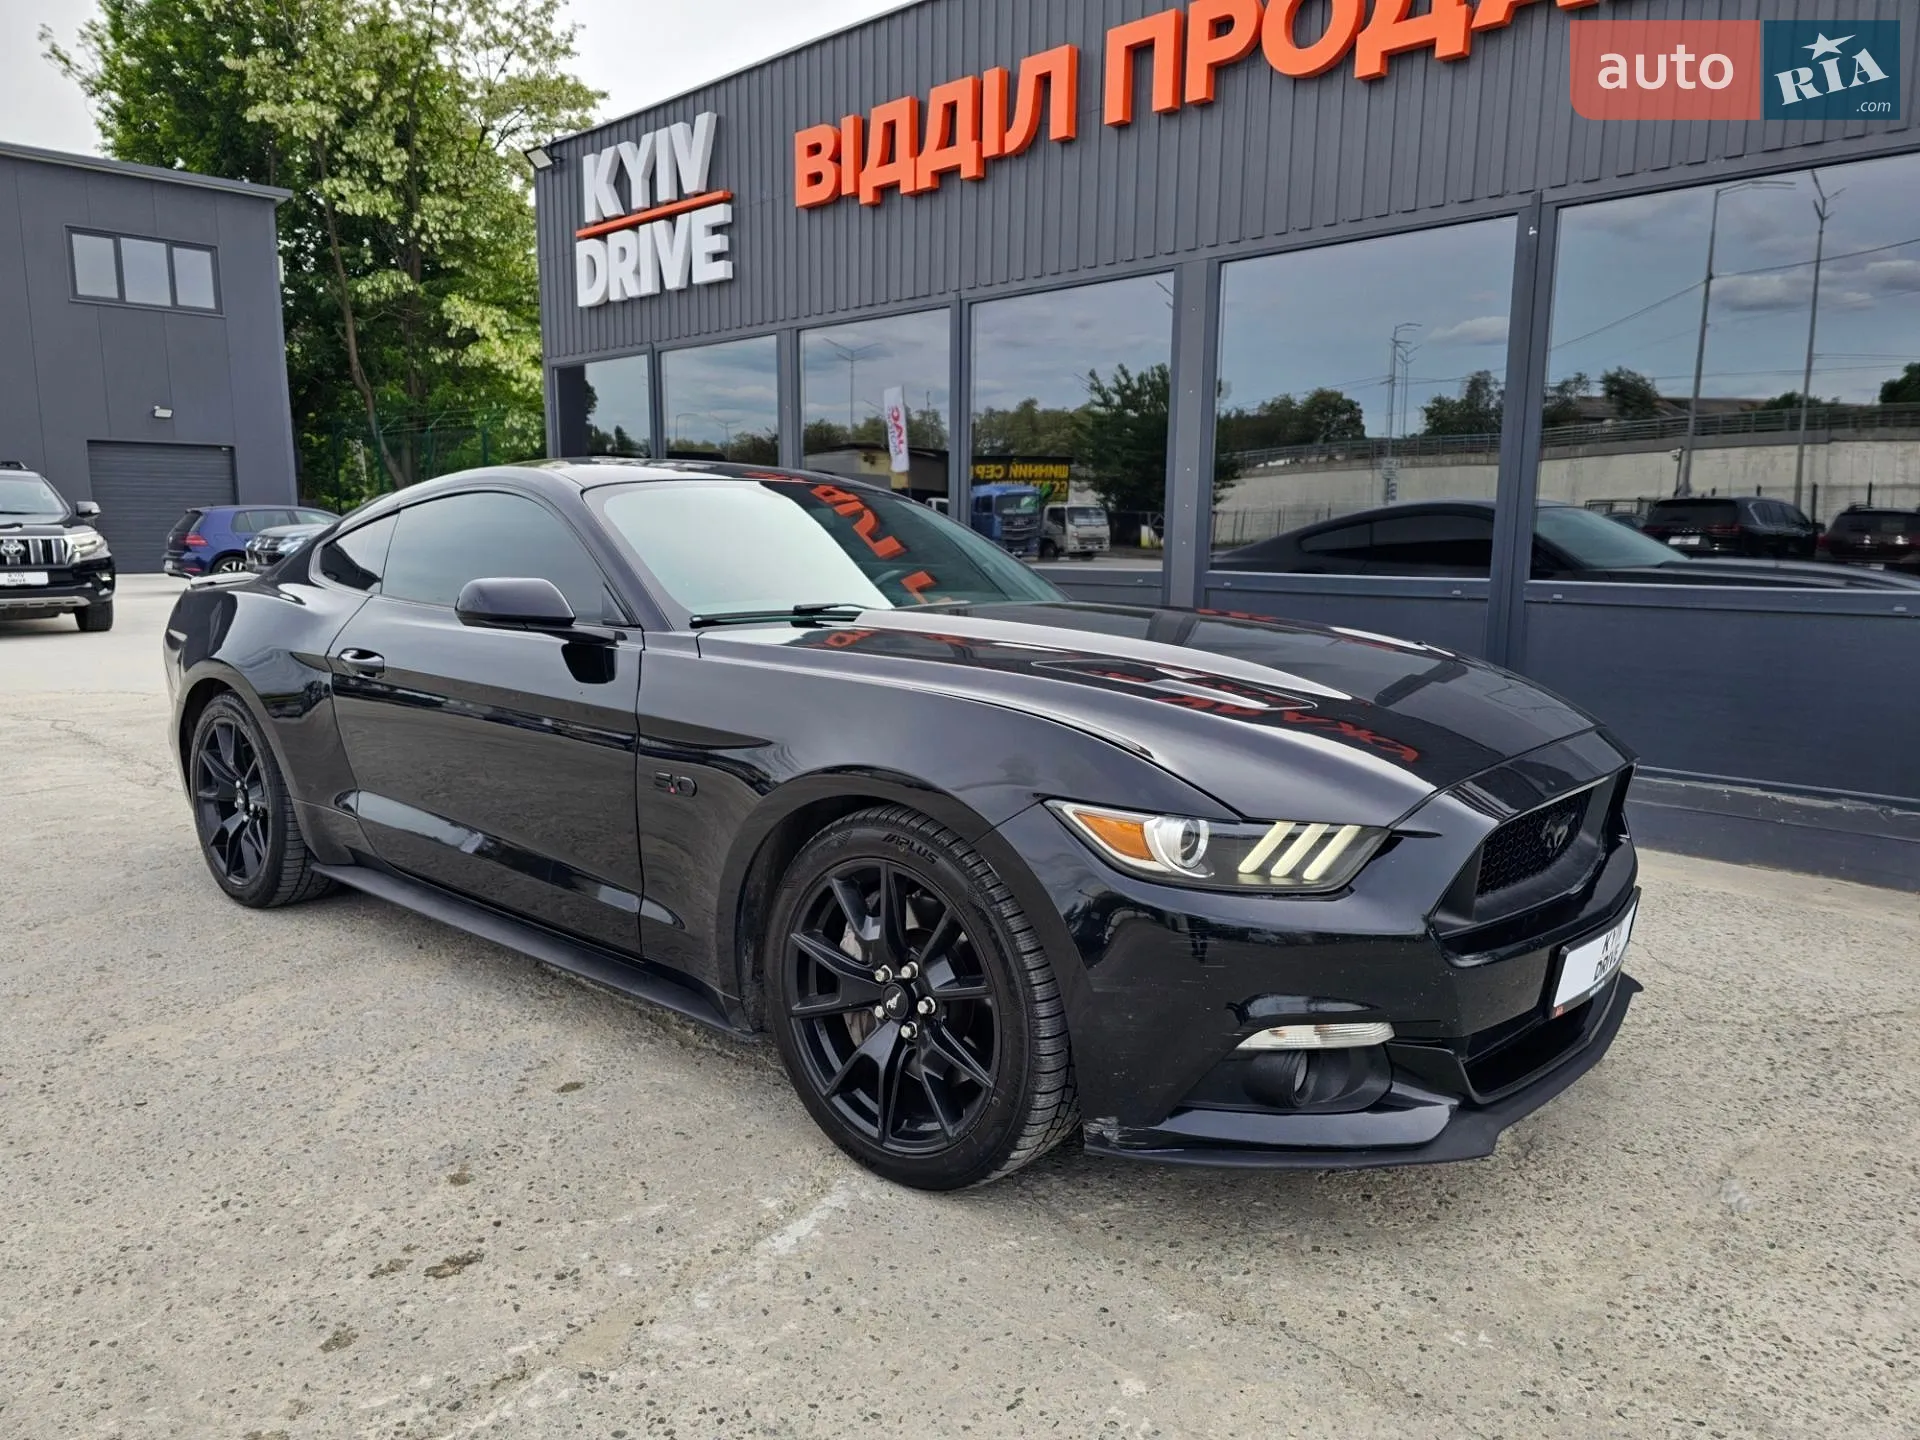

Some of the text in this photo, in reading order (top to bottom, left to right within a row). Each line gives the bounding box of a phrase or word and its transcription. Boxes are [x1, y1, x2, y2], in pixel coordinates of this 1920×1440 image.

[794, 0, 1603, 209] ВІДДІЛ ПРОД
[583, 111, 718, 224] KYIV
[575, 203, 733, 307] DRIVE
[654, 769, 698, 798] 5.0
